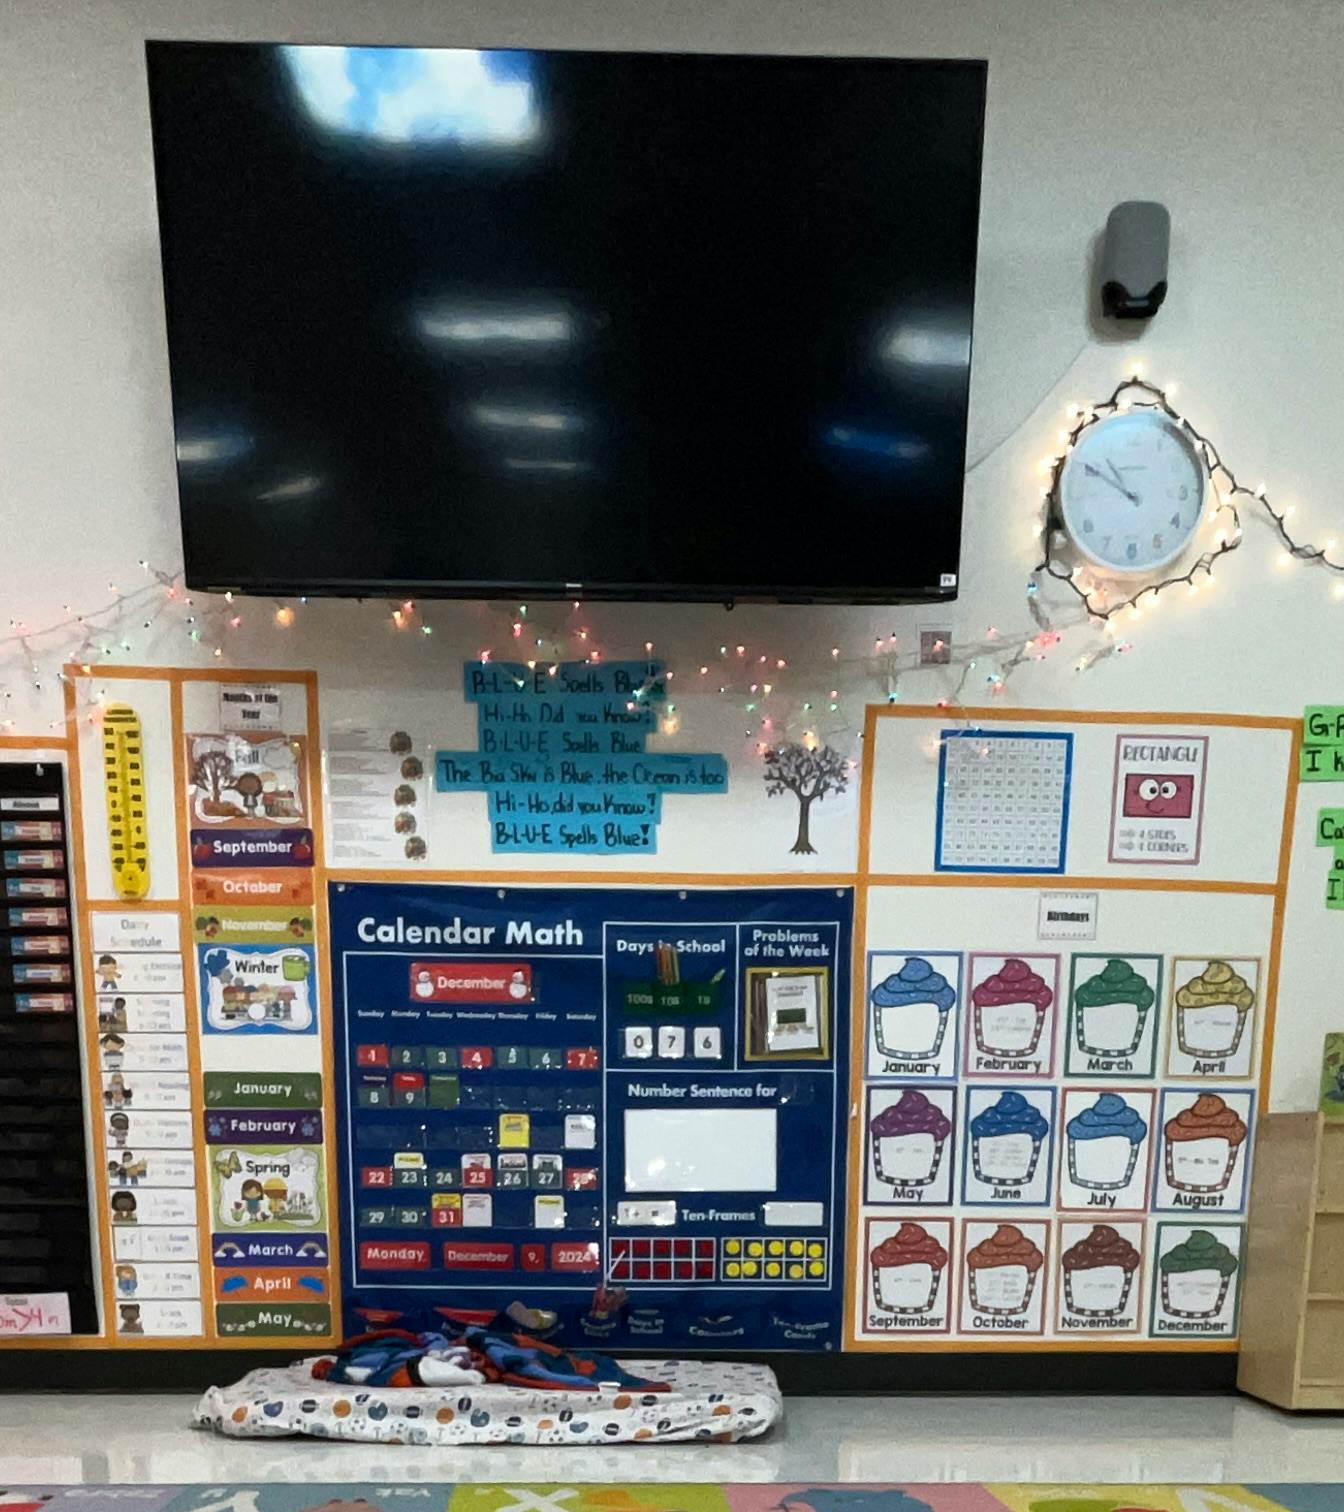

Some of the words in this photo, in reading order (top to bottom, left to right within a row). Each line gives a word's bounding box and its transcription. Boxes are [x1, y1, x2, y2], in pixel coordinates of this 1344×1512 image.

[1305, 750, 1322, 773] I
[440, 760, 471, 783] The
[602, 760, 627, 784] the
[632, 763, 681, 784] Ocean
[698, 765, 724, 784] too
[494, 823, 553, 845] B-L-U-E
[559, 823, 598, 847] Spells
[605, 824, 650, 846] Blue!
[212, 840, 293, 856] September
[223, 880, 283, 895] October
[1327, 878, 1341, 901] I
[221, 918, 289, 932] November
[357, 917, 496, 945] Calendar
[505, 919, 584, 946] Math
[752, 929, 820, 943] Problems
[616, 939, 654, 955] Days
[675, 939, 727, 954] School
[743, 944, 760, 957] of
[762, 944, 784, 957] the
[788, 944, 830, 958] Week
[234, 952, 280, 975] Winter
[437, 976, 506, 990] December
[633, 1034, 645, 1049] 0
[667, 1035, 677, 1049] 7
[702, 1036, 713, 1049] 6
[402, 1050, 412, 1063] 2
[438, 1051, 447, 1064] 3
[471, 1051, 482, 1063] 4
[542, 1052, 551, 1064] 6
[577, 1052, 587, 1065] 7
[975, 1056, 1042, 1074] February
[1086, 1057, 1134, 1072] March
[881, 1059, 942, 1076] January
[1191, 1059, 1226, 1075] April
[232, 1082, 293, 1098] January
[369, 1091, 379, 1104] 8
[405, 1091, 415, 1104] 9
[627, 1083, 686, 1099] Number
[689, 1084, 753, 1099] Sentence
[755, 1083, 778, 1100] for
[229, 1118, 297, 1133] February
[245, 1160, 291, 1176] Spring
[368, 1171, 385, 1184] 22
[401, 1171, 418, 1184] 23
[435, 1172, 453, 1185] 24
[469, 1171, 487, 1184] 25
[504, 1172, 522, 1185] 26
[538, 1172, 554, 1185] 27
[892, 1186, 924, 1203] May
[989, 1186, 1022, 1200] June
[1086, 1191, 1117, 1209] July
[1171, 1192, 1225, 1210] August
[368, 1211, 385, 1224] 29
[400, 1211, 419, 1224] 30
[438, 1210, 455, 1224] 31
[681, 1208, 756, 1224] Ten-Frames
[247, 1244, 294, 1257] March
[447, 1250, 509, 1263] December
[557, 1250, 592, 1264] 2024
[254, 1277, 292, 1293] April
[258, 1312, 293, 1330] May
[868, 1314, 944, 1331] September
[972, 1315, 1030, 1329] October
[1060, 1315, 1135, 1330] November
[1157, 1318, 1228, 1332] December
